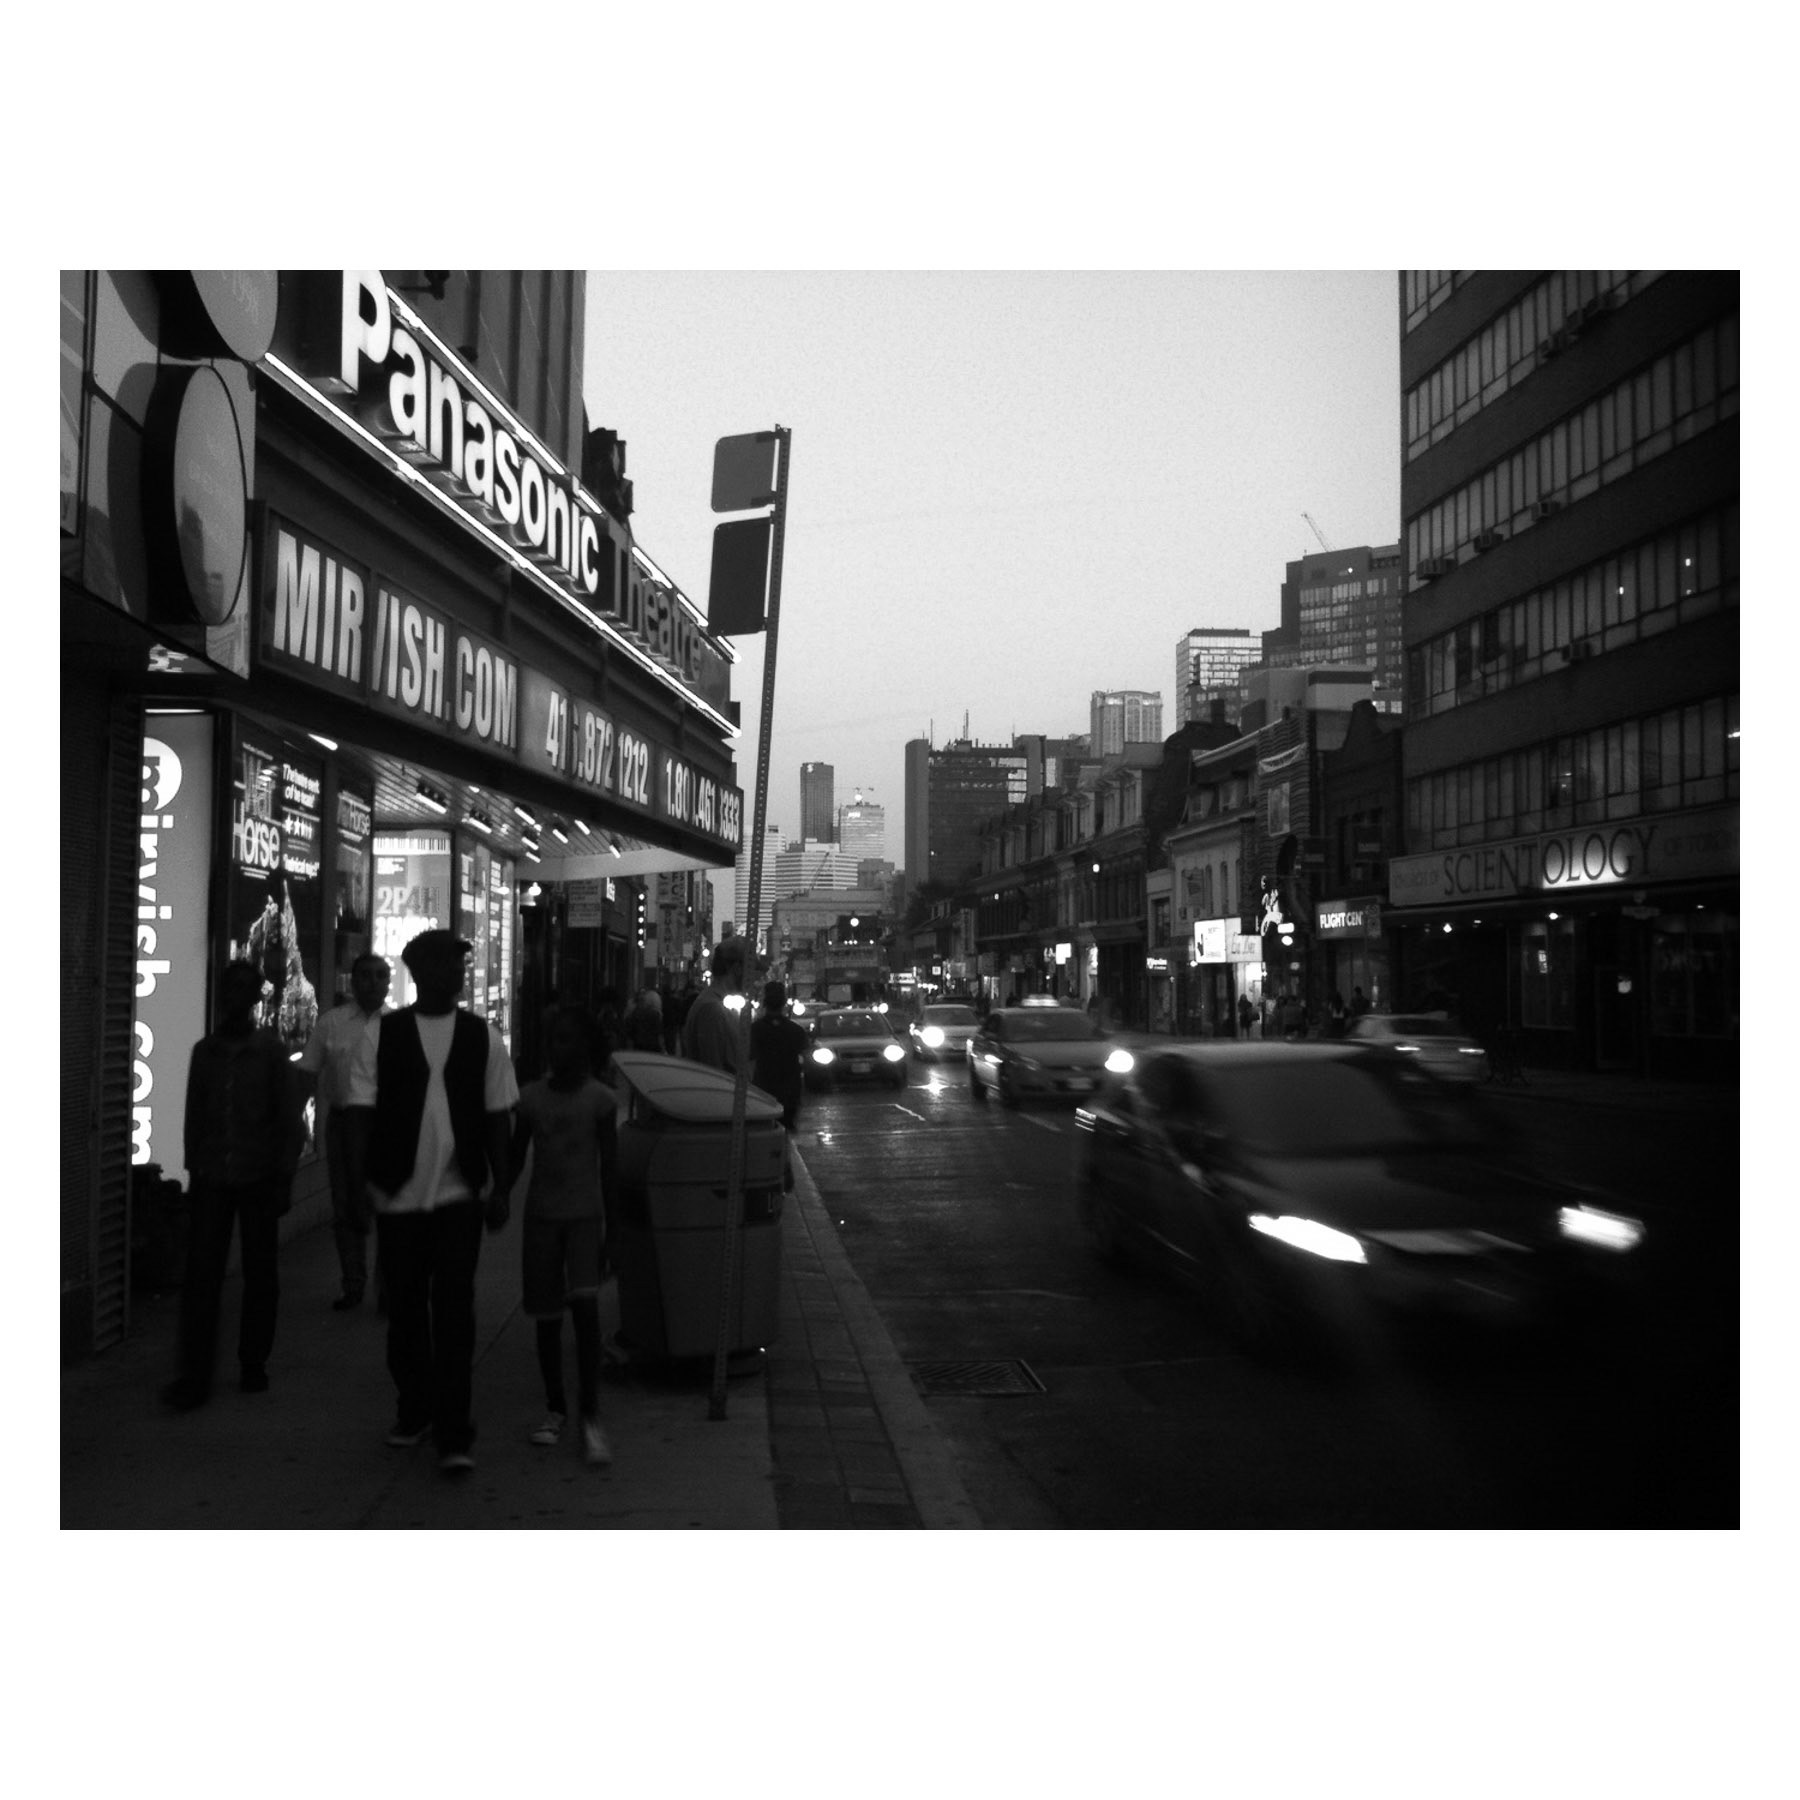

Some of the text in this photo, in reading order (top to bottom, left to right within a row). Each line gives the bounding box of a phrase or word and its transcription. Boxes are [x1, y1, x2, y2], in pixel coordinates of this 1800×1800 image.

[341, 270, 701, 683] Panasonic Theatre
[232, 799, 281, 870] Horse
[1443, 824, 1658, 897] SCIENTOLOGY
[1319, 911, 1346, 929] FLIGHT
